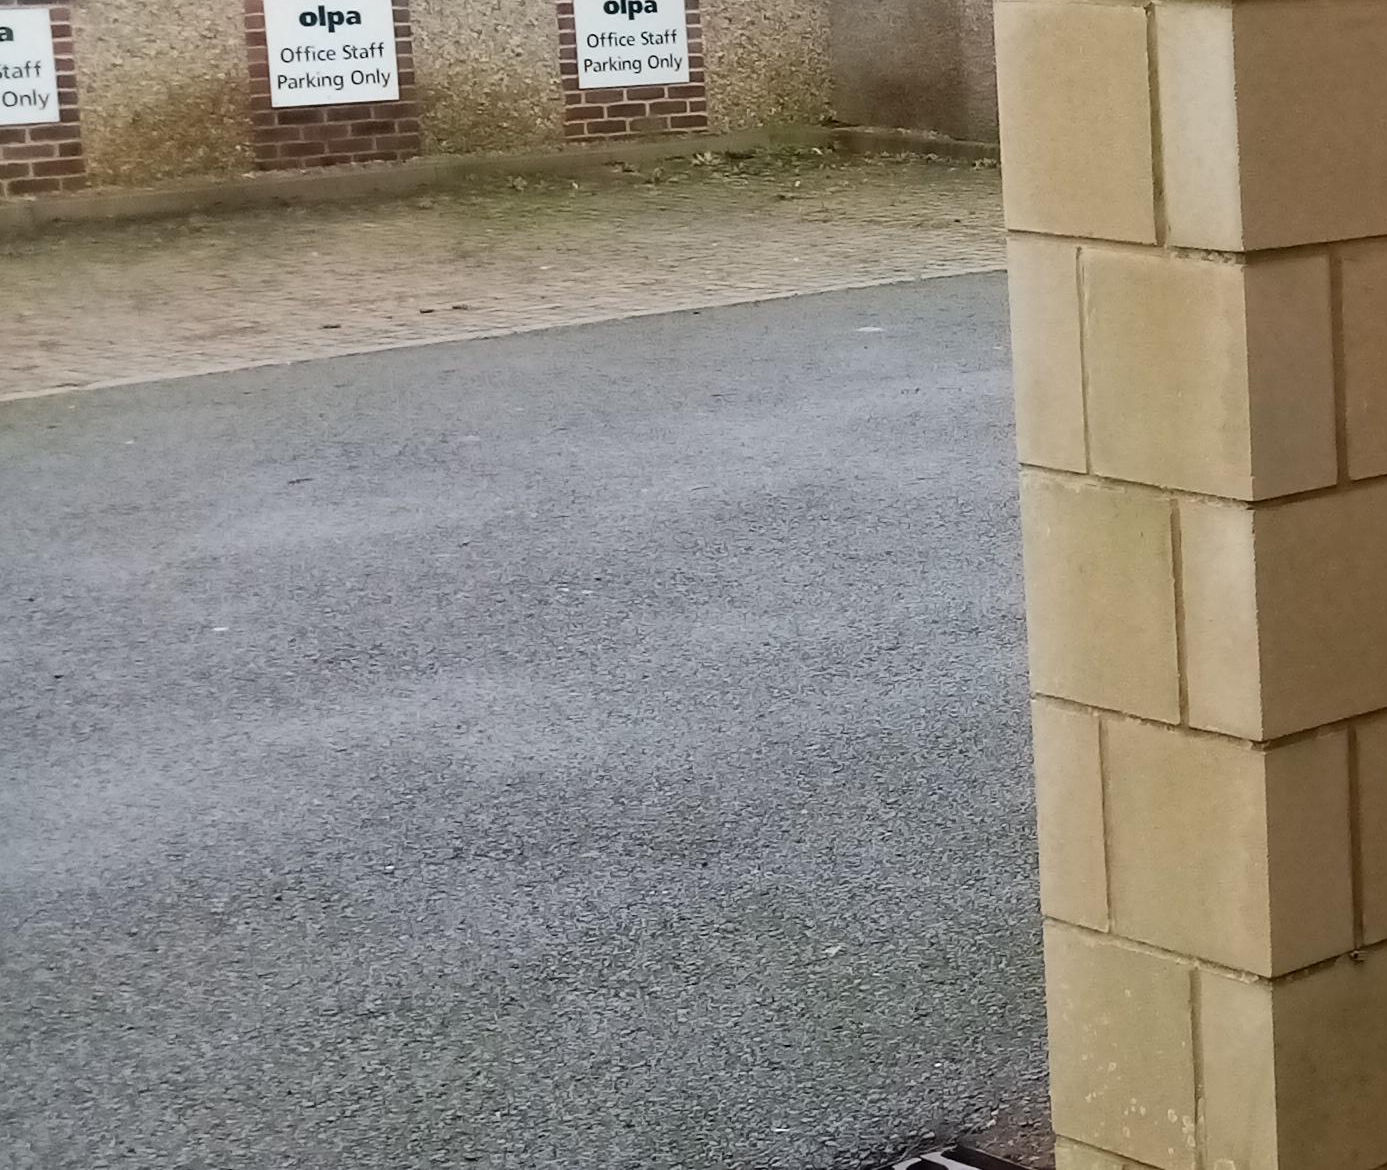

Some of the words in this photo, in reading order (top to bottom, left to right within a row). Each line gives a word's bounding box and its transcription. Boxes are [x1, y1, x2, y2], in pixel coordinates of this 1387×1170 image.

[299, 5, 361, 33] olpa
[587, 31, 636, 48] Office
[640, 29, 678, 46] Staff
[280, 45, 337, 63] Office
[342, 42, 385, 60] Staff
[0, 60, 41, 79] taff
[583, 56, 642, 74] Parking
[647, 53, 683, 72] Only
[277, 72, 344, 90] Parking
[351, 68, 391, 88] Only
[2, 89, 50, 111] Only
